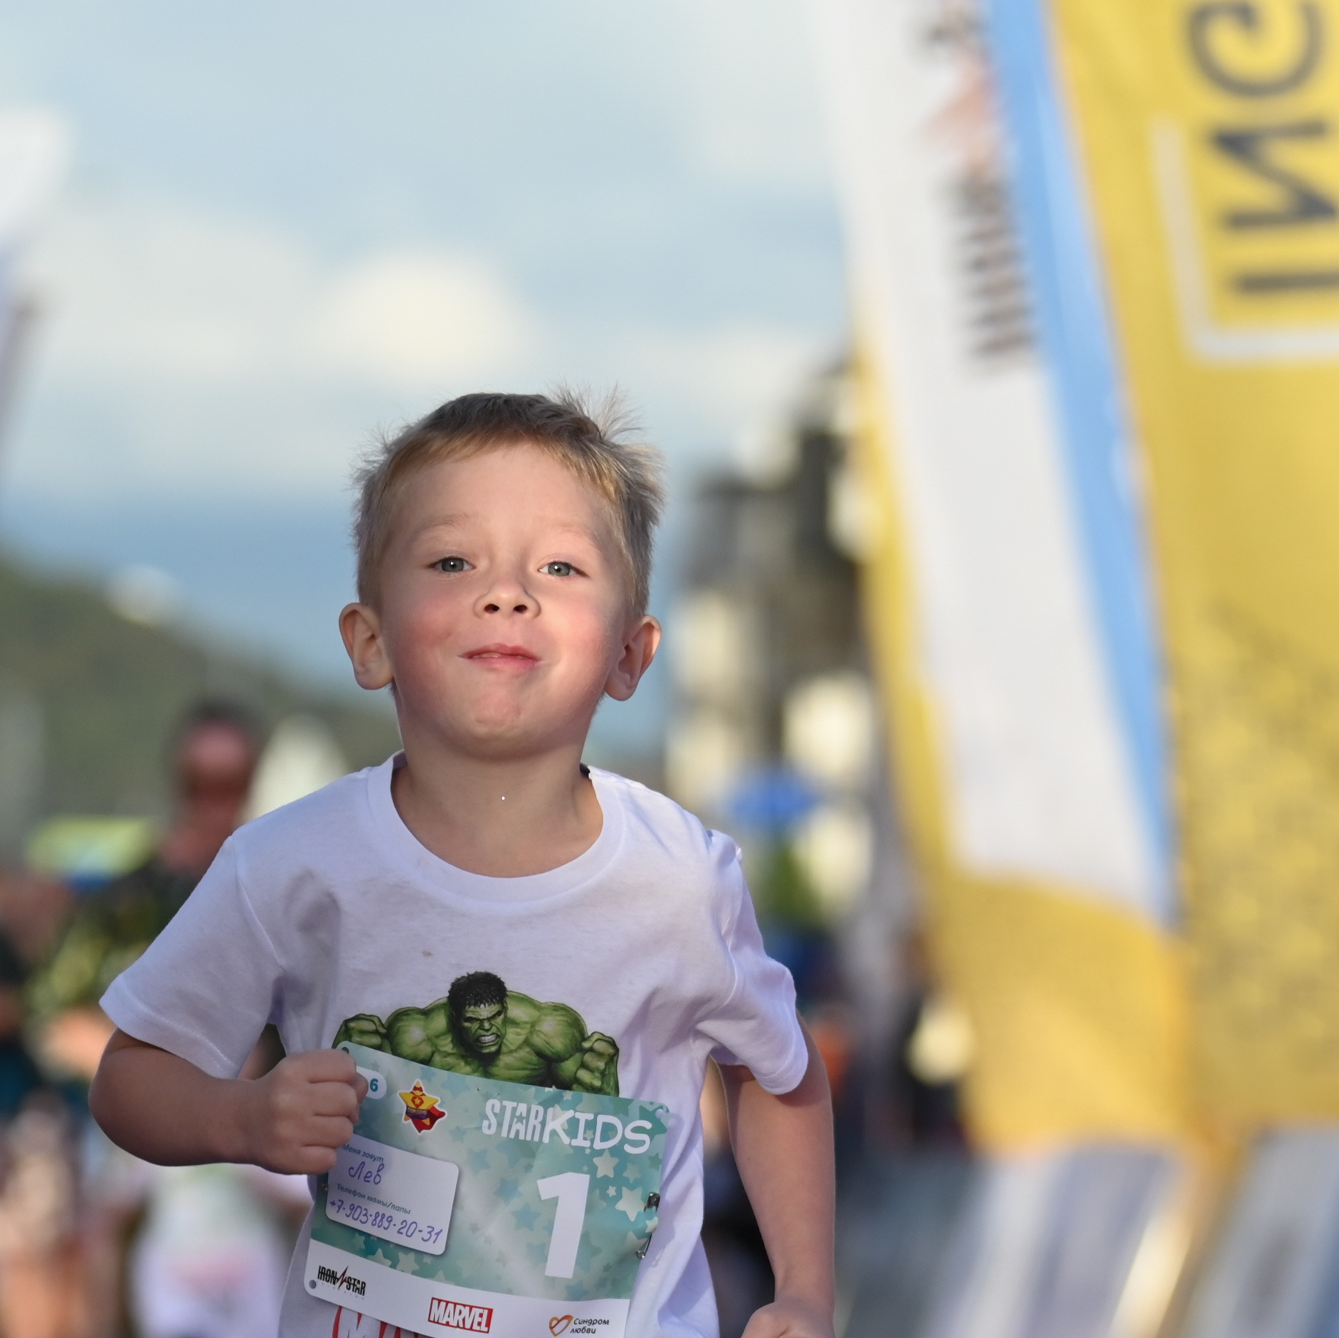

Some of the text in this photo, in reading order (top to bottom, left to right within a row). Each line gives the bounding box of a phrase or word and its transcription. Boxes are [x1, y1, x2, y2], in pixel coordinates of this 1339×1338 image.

[348, 1161, 385, 1185] Лев
[337, 1183, 366, 1199] Телефон
[536, 1172, 590, 1279] 1
[430, 1299, 492, 1332] MARVEL
[573, 1318, 610, 1326] Синдром
[570, 1326, 596, 1334] любви
